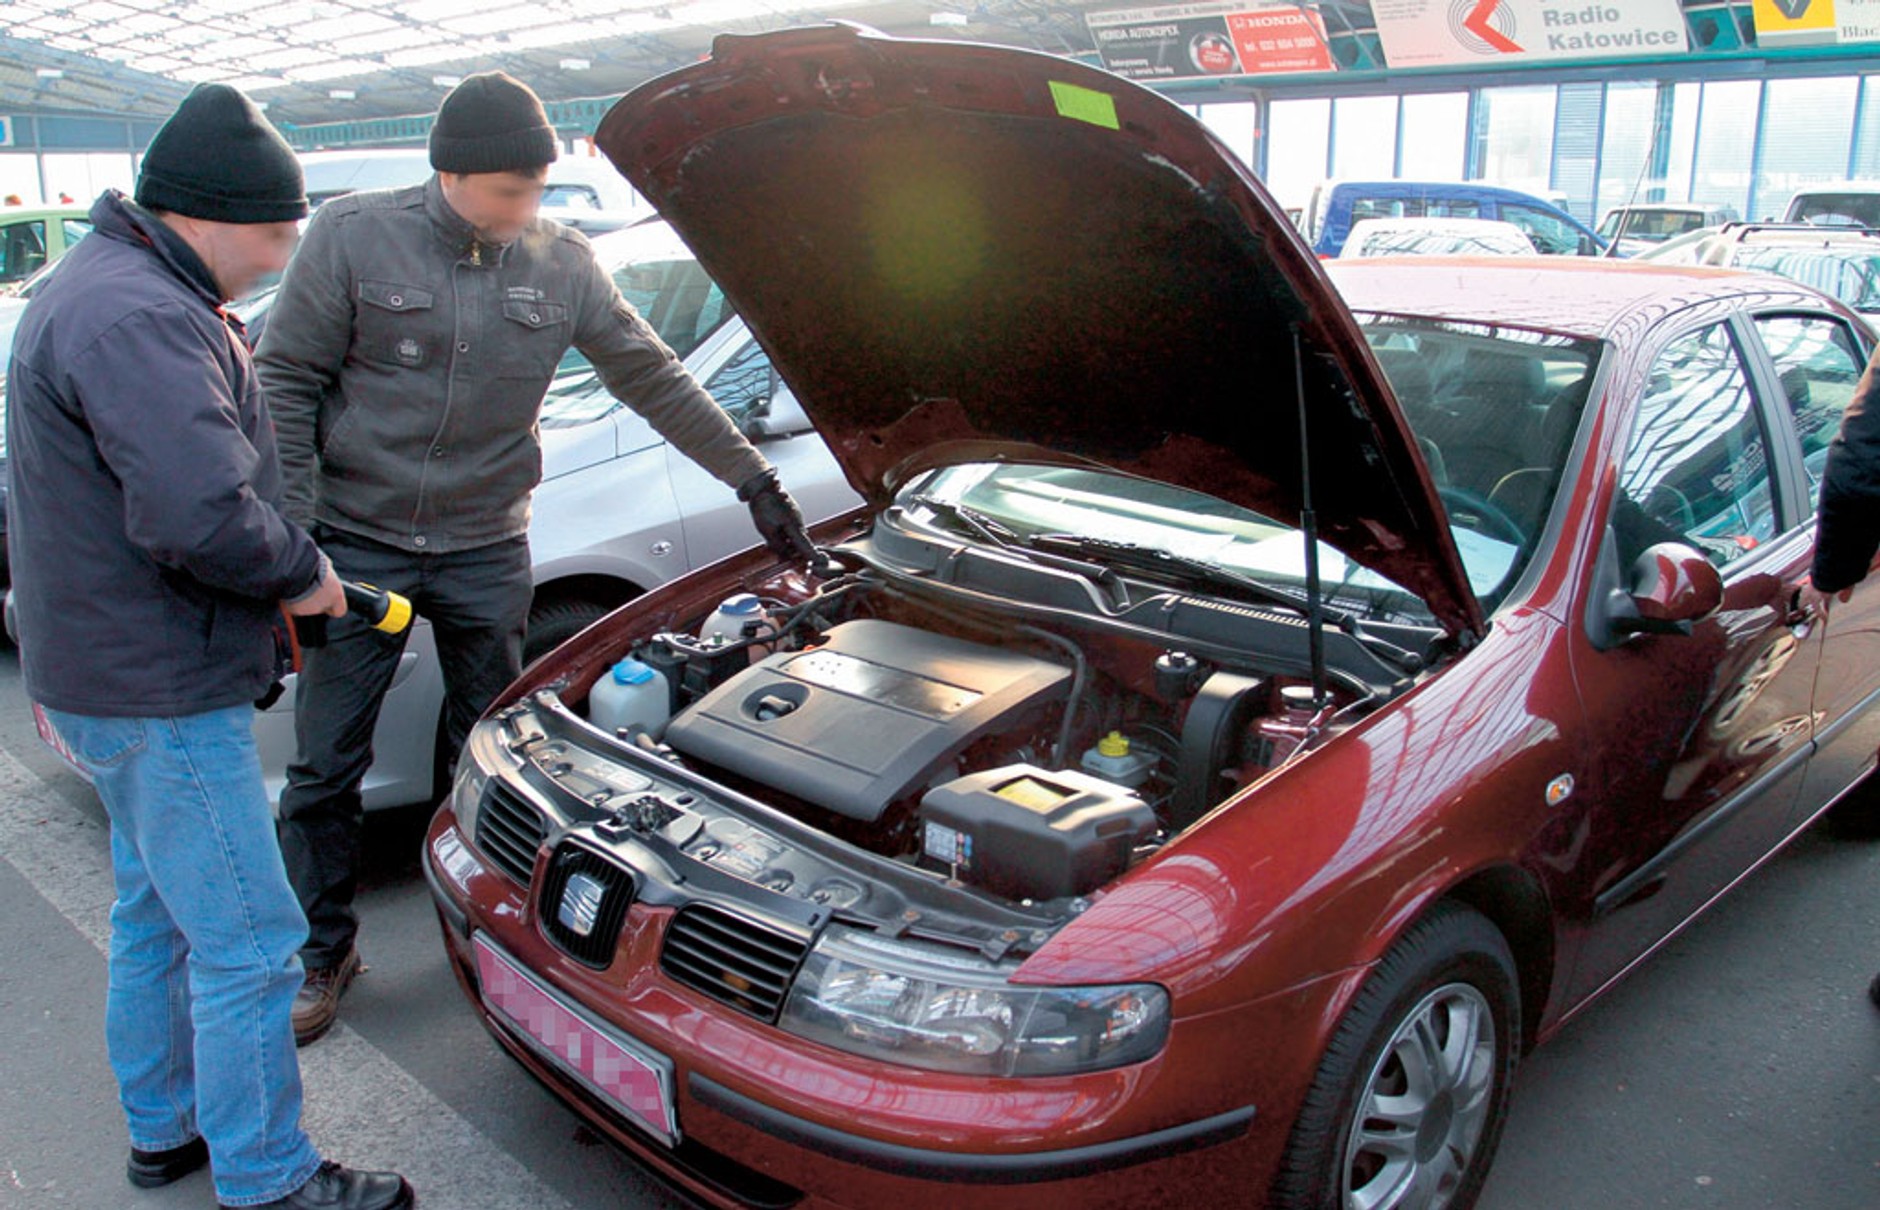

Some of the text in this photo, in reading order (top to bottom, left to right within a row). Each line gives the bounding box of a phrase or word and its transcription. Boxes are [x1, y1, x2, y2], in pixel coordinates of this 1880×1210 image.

[1247, 14, 1308, 28] HONDA
[1542, 5, 1620, 27] Radio
[1547, 28, 1679, 51] Katowice
